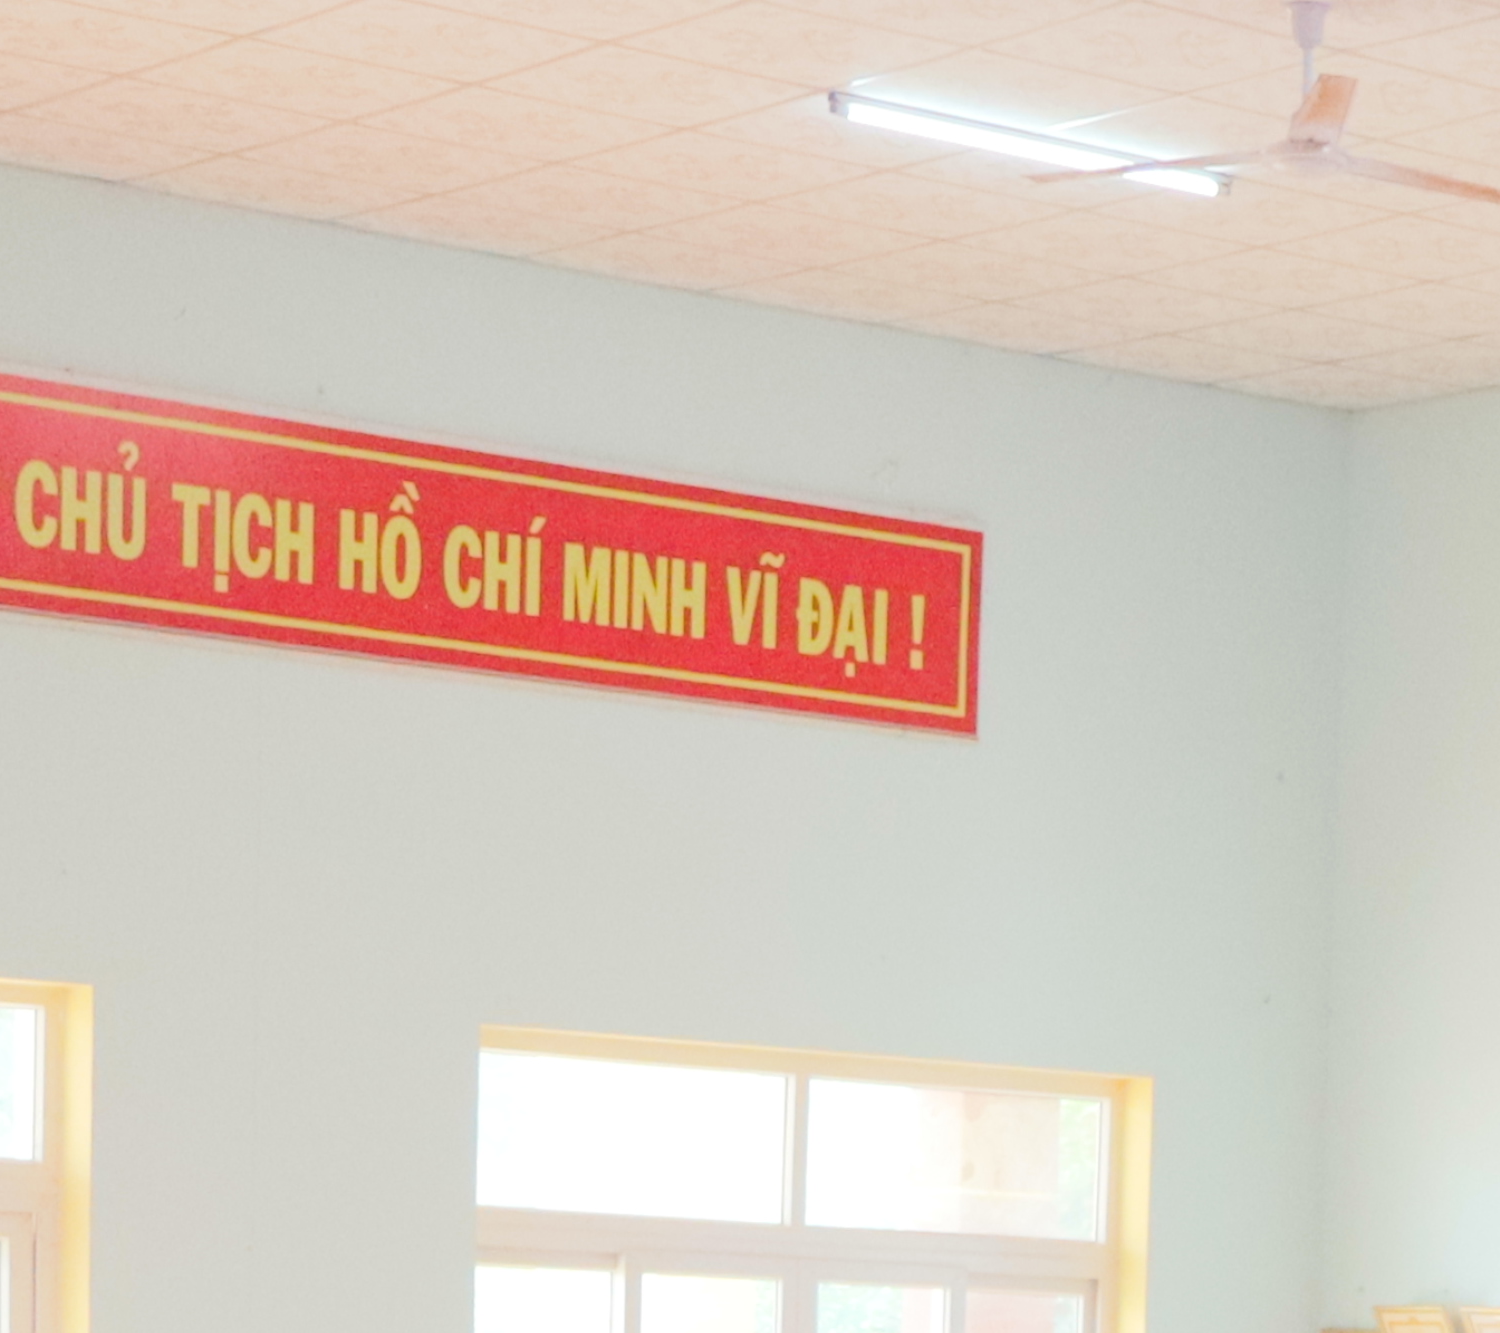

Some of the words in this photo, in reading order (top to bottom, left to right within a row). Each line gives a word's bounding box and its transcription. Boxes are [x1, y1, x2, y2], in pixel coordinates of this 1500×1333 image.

[14, 440, 148, 561] CHỦ
[170, 482, 315, 593] TỊCH
[338, 480, 422, 600] HỒ
[443, 516, 550, 617] CHÍ
[562, 542, 707, 639] MINH
[726, 551, 785, 649] VĨ
[795, 577, 889, 677] ĐẠI
[909, 594, 926, 670] !
